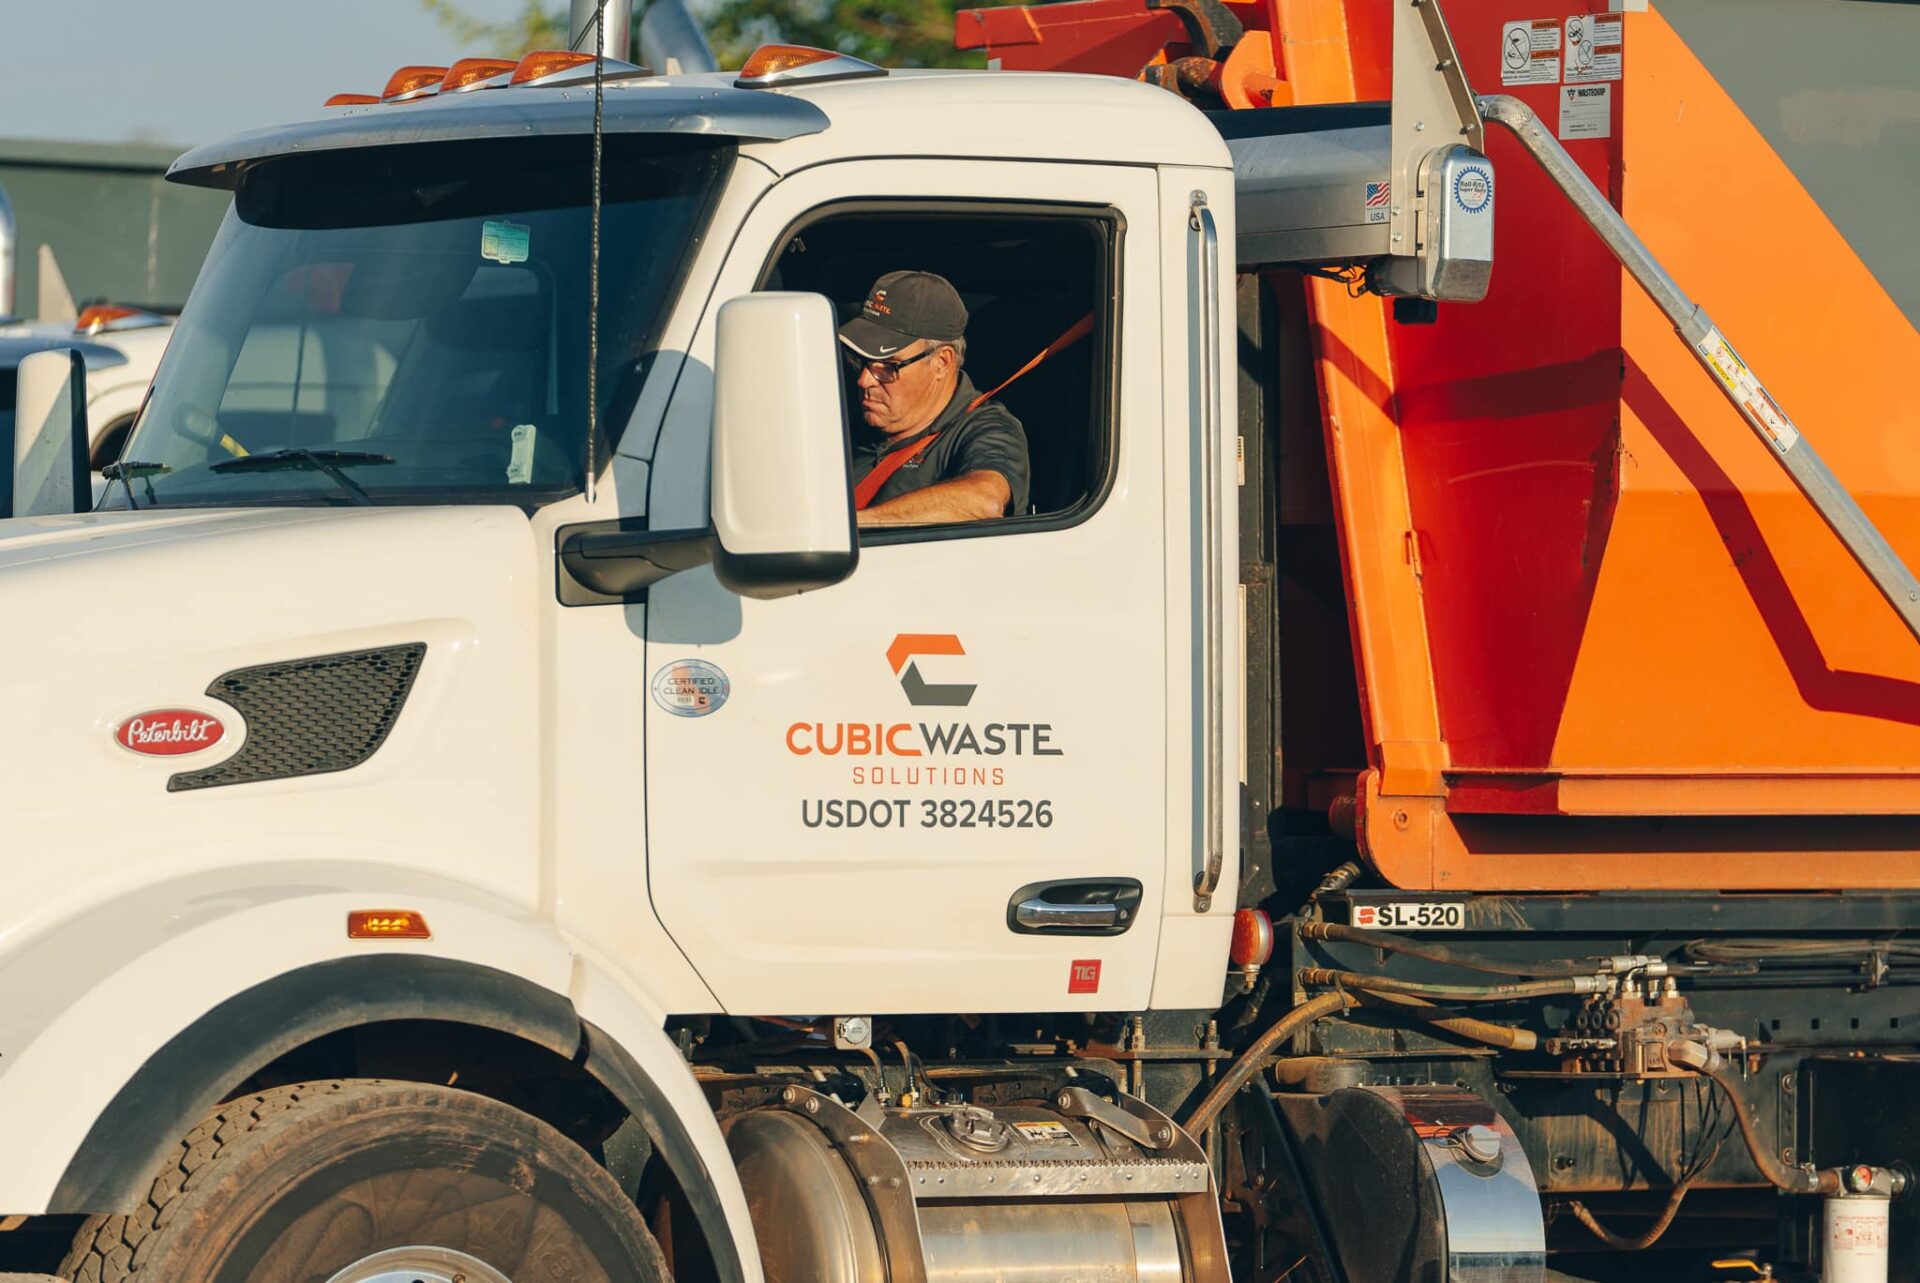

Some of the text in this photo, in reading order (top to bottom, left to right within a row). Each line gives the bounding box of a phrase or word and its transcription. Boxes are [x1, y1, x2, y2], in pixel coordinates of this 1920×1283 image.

[1370, 211, 1386, 222] USA
[662, 687, 695, 695] CLEAN
[667, 677, 715, 685] CERTIFIED
[127, 718, 217, 747] Peterbilt
[852, 766, 1005, 786] SOLUTIONS
[802, 799, 1054, 829] USDOT 3824526
[1378, 906, 1460, 927] SL-520
